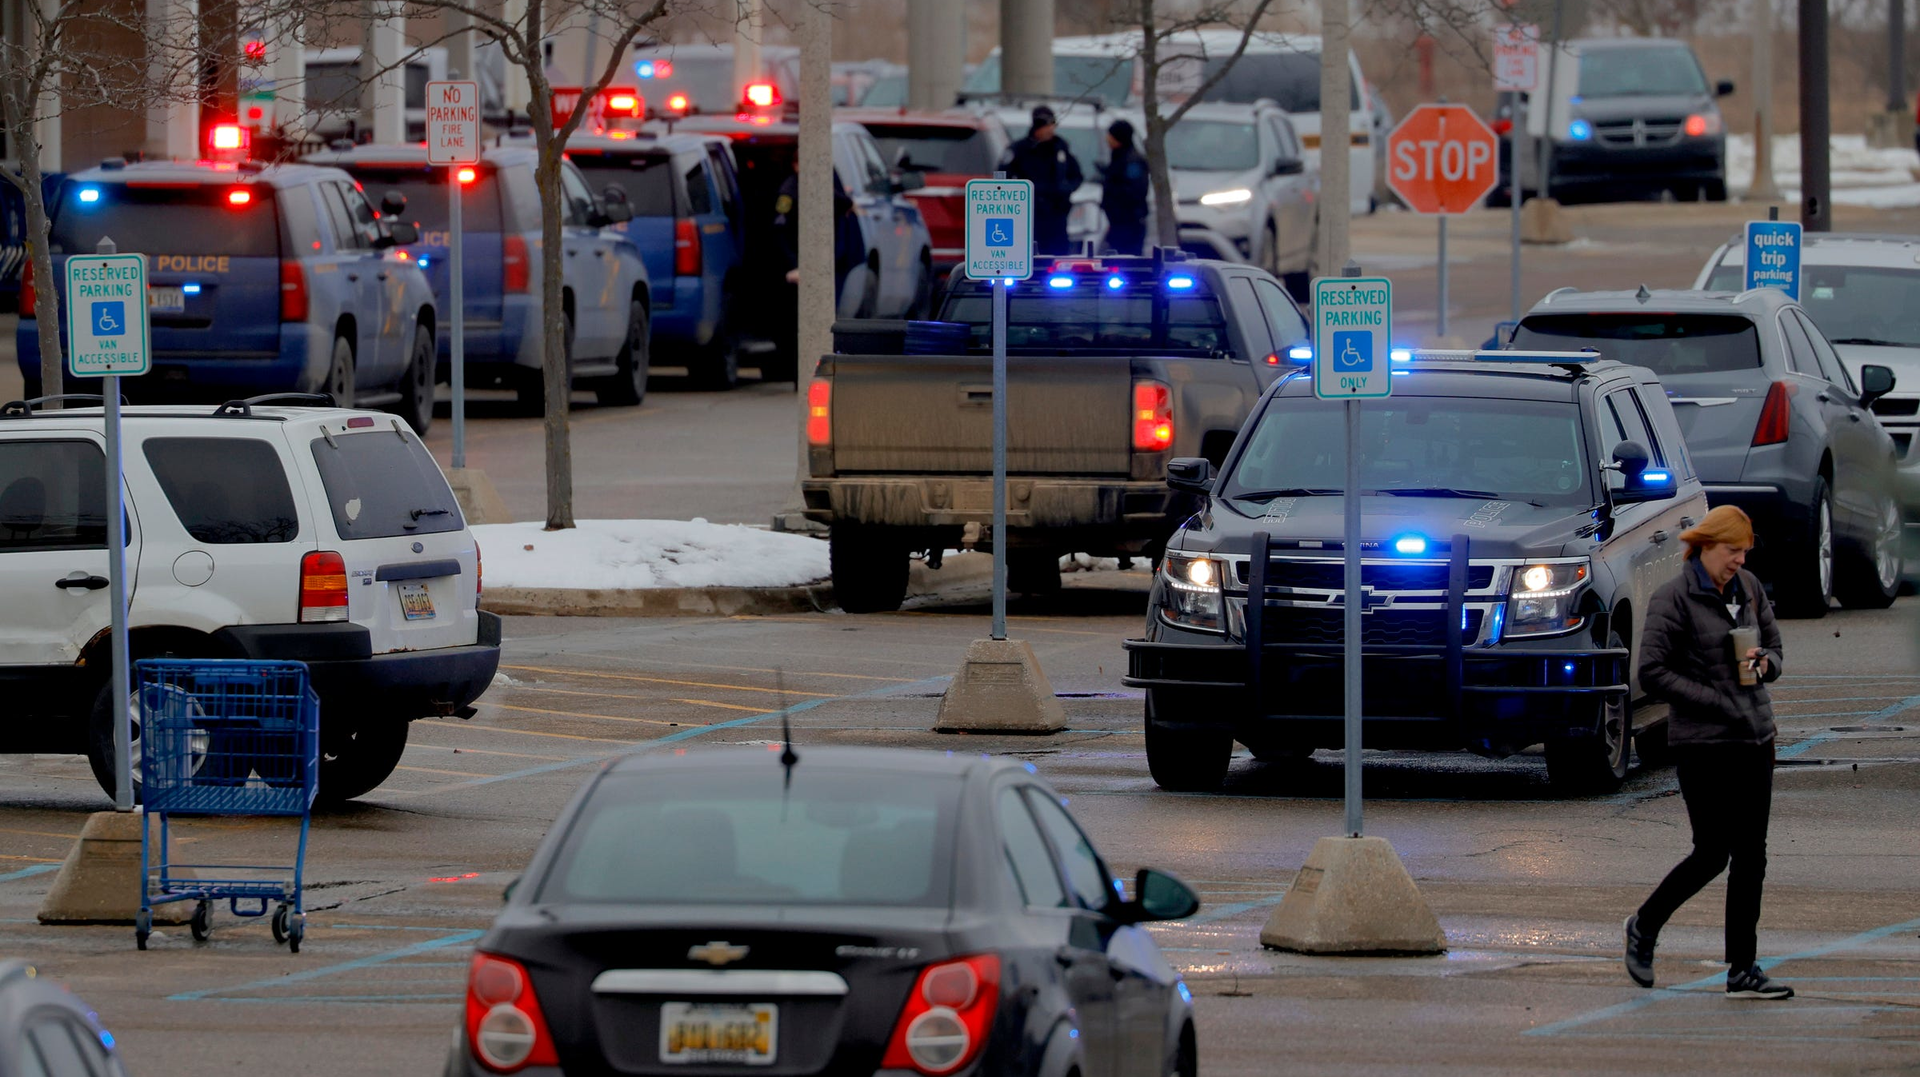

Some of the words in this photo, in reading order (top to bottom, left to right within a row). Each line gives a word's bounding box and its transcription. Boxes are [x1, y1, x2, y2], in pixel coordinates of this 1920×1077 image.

[443, 88, 461, 104] NO
[430, 106, 475, 122] PARKING
[442, 124, 463, 135] FIRE
[440, 137, 465, 148] LANE
[1395, 140, 1491, 181] STOP
[971, 190, 1026, 201] RESERVED
[976, 204, 1021, 215] PARKING
[1754, 231, 1794, 249] quick
[991, 250, 1006, 258] VAN
[1761, 250, 1786, 268] trip
[158, 254, 230, 273] POLICE
[972, 261, 1023, 269] ACCESSIBLE
[73, 267, 138, 281] RESERVED
[1753, 268, 1793, 282] parking
[80, 283, 132, 297] PARKING
[1321, 290, 1386, 306] RESERVED
[1326, 310, 1382, 326] PARKING
[99, 340, 117, 350] VAN
[78, 352, 138, 363] ACCESSIBLE
[1340, 377, 1367, 389] ONLY
